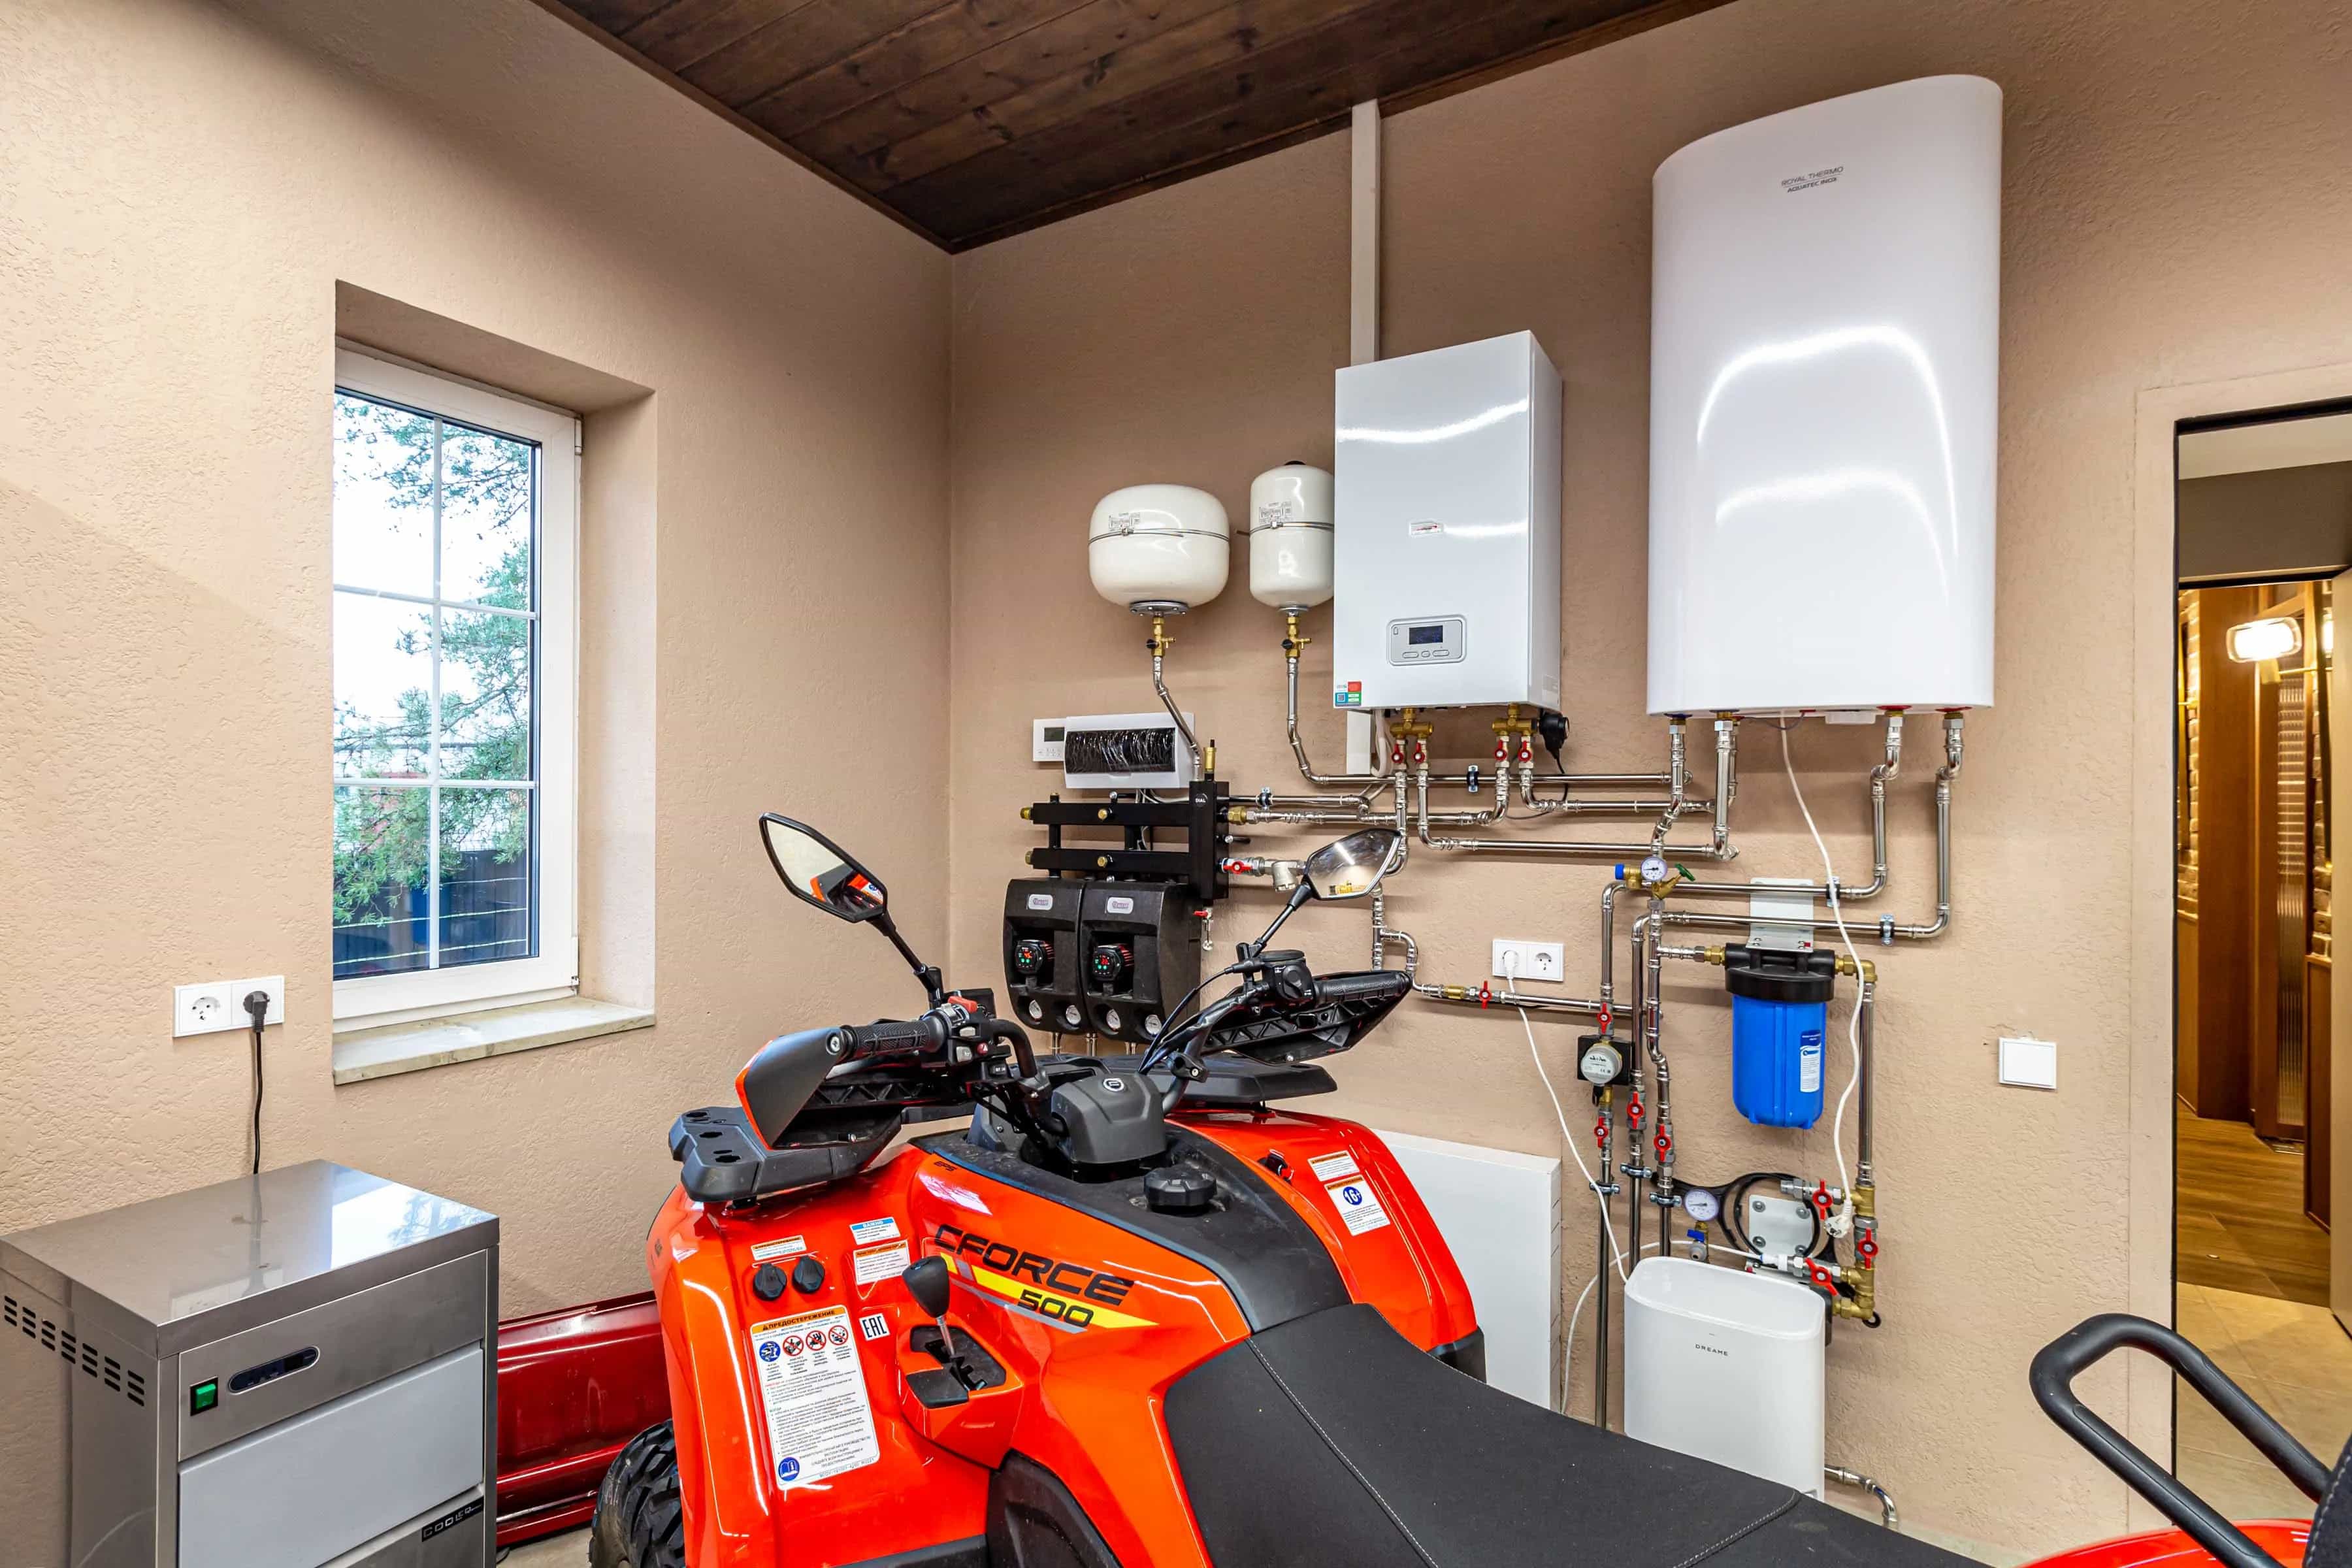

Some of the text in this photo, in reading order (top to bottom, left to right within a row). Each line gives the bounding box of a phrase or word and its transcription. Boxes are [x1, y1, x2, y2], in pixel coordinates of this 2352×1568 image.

[1781, 166, 1844, 186] ROYAL THERMO
[934, 1160, 957, 1171] EPS
[1344, 1189, 1361, 1203] 16+
[934, 1224, 1134, 1306] CFORCE
[1018, 1289, 1094, 1328] 500
[768, 1310, 836, 1329] ПРЕДОСТЕРЕЖЕНИЕ
[862, 1316, 887, 1338] EAC
[1695, 1344, 1729, 1356] DREAME
